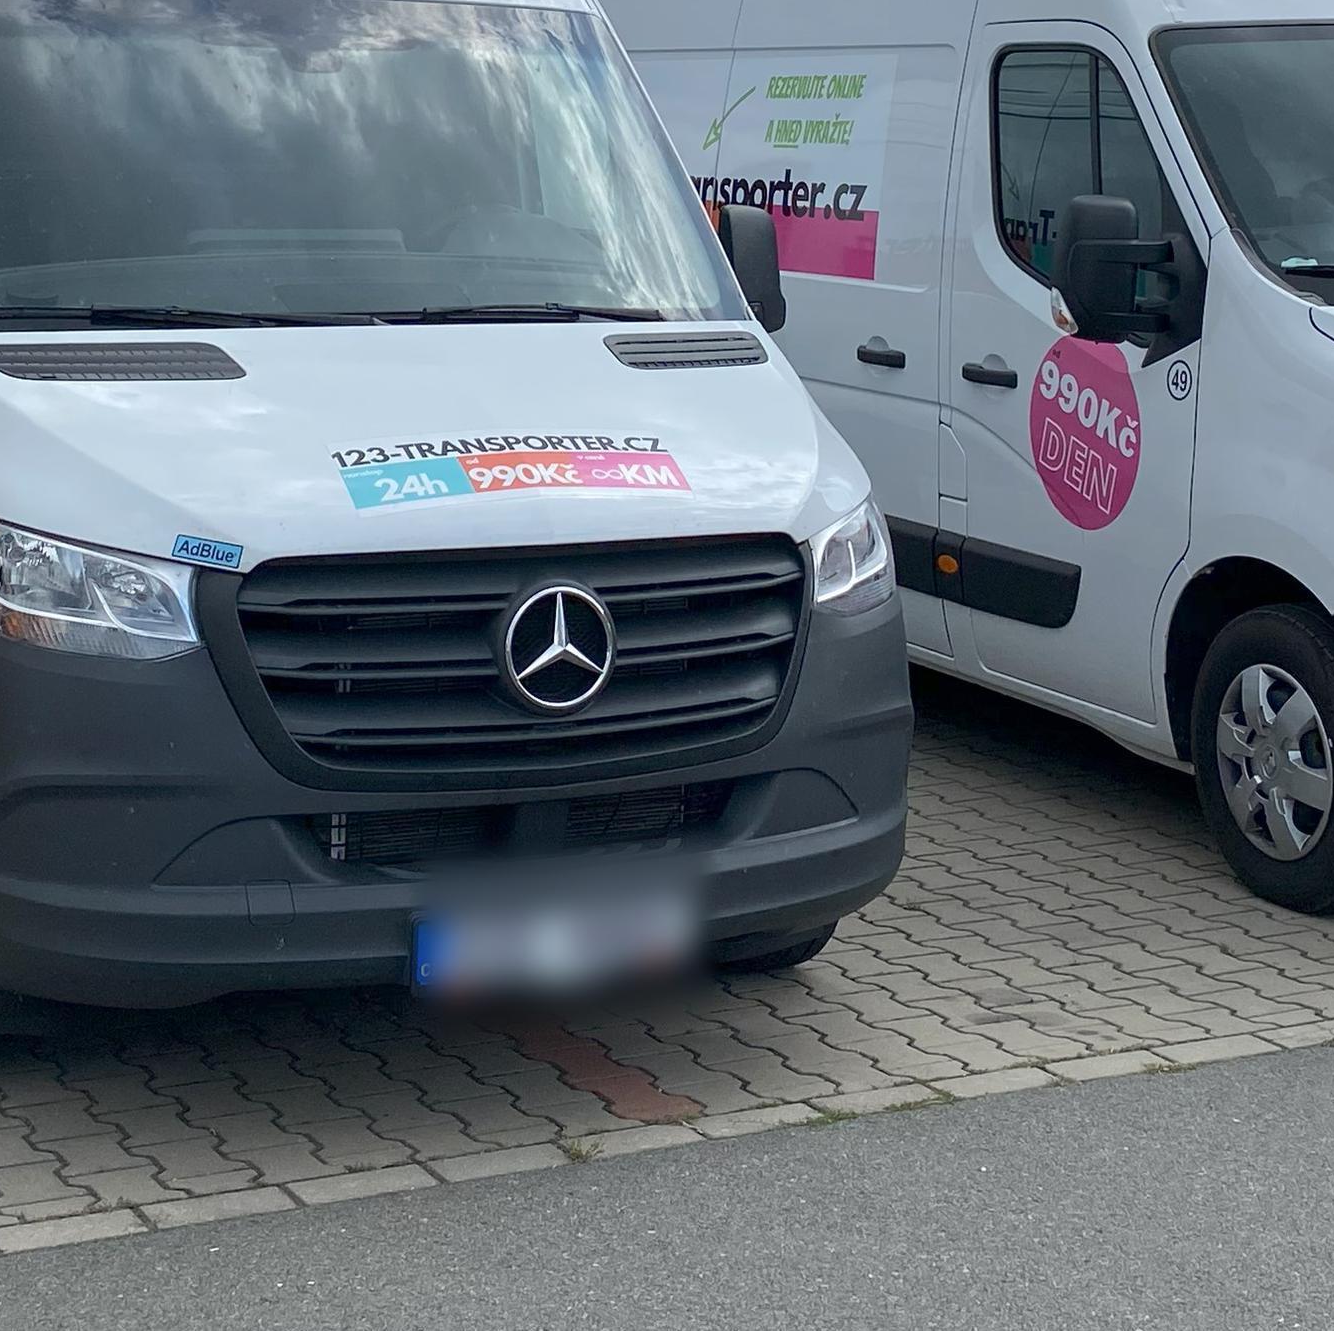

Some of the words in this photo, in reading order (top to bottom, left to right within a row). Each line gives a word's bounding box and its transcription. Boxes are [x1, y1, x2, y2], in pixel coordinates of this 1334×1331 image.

[766, 75, 828, 99] REZERVUJTE
[826, 74, 868, 99] ONLINE
[764, 120, 772, 143] A
[773, 120, 802, 144] HNED
[802, 113, 855, 146] VYRAŽTE!
[689, 168, 868, 222] ansporter.cz
[1171, 369, 1188, 392] 49
[1039, 360, 1139, 458] 990Kč
[331, 435, 670, 468] 123-TRANSPORTER.CZ
[1038, 417, 1117, 515] DEN
[373, 472, 449, 503] 24h
[468, 463, 584, 489] 990Kč
